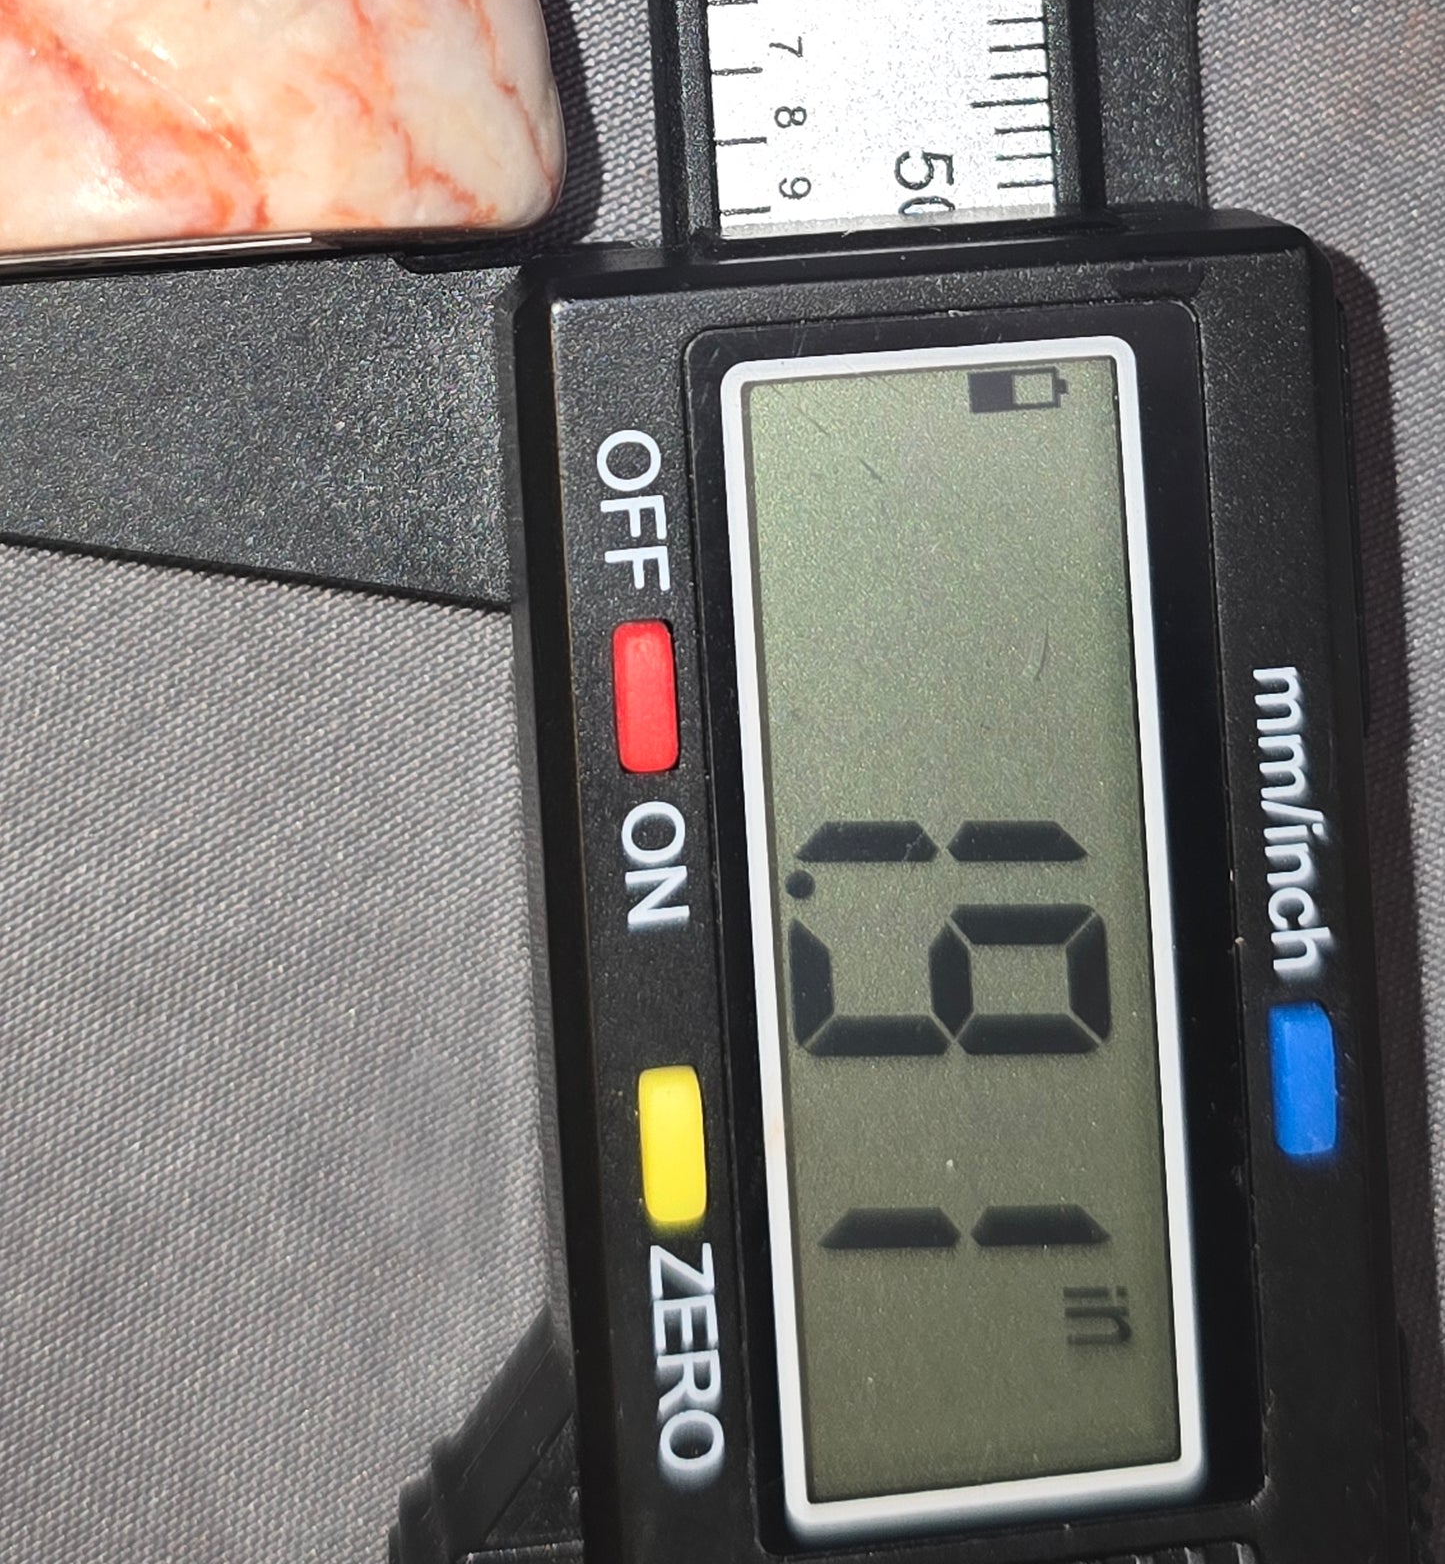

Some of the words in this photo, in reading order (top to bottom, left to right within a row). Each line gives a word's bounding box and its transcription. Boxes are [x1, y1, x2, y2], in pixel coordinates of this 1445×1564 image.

[768, 35, 803, 59] 7
[773, 105, 808, 129] 8
[778, 176, 812, 200] 9
[596, 429, 670, 593] OFF
[621, 801, 690, 930] ON
[1252, 666, 1332, 973] mm/inch
[788, 820, 1111, 1249] 1.91
[1063, 1285, 1132, 1348] in
[650, 1242, 725, 1476] ZERO
